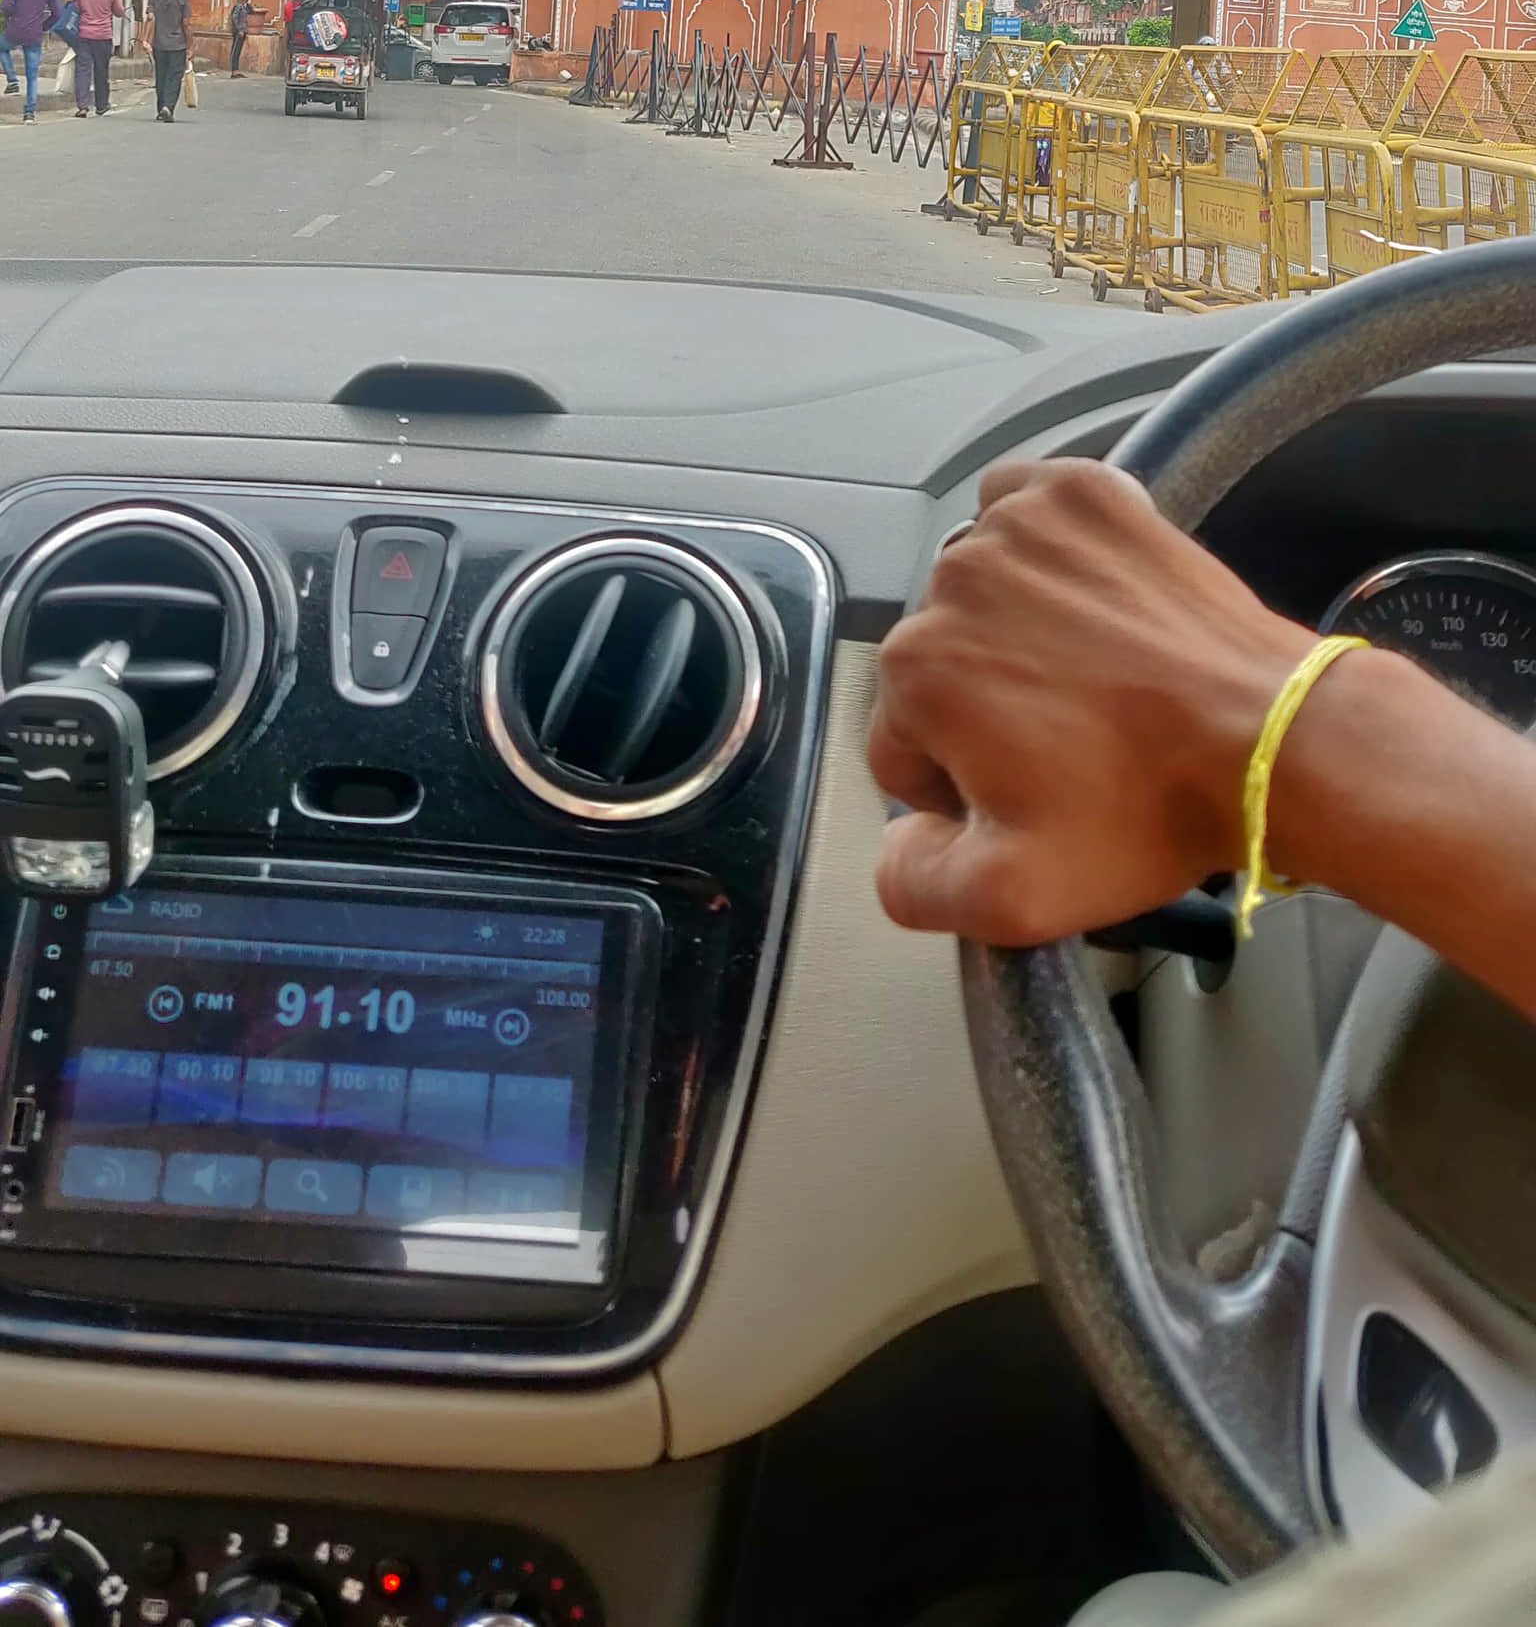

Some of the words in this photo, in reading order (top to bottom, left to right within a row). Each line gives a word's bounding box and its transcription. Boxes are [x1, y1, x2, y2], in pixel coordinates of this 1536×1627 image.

[1402, 618, 1424, 636] 90
[1441, 616, 1465, 632] 110
[1480, 631, 1508, 648] 130
[1512, 658, 1536, 676] 150
[150, 901, 203, 920] RADIO
[89, 958, 134, 977] 87.50
[193, 991, 235, 1012] FM1
[275, 981, 416, 1034] 91.10
[536, 988, 591, 1009] 108.00
[445, 1008, 488, 1029] MHz
[226, 1532, 243, 1556] 2
[272, 1523, 289, 1548] 3
[314, 1540, 330, 1564] 4
